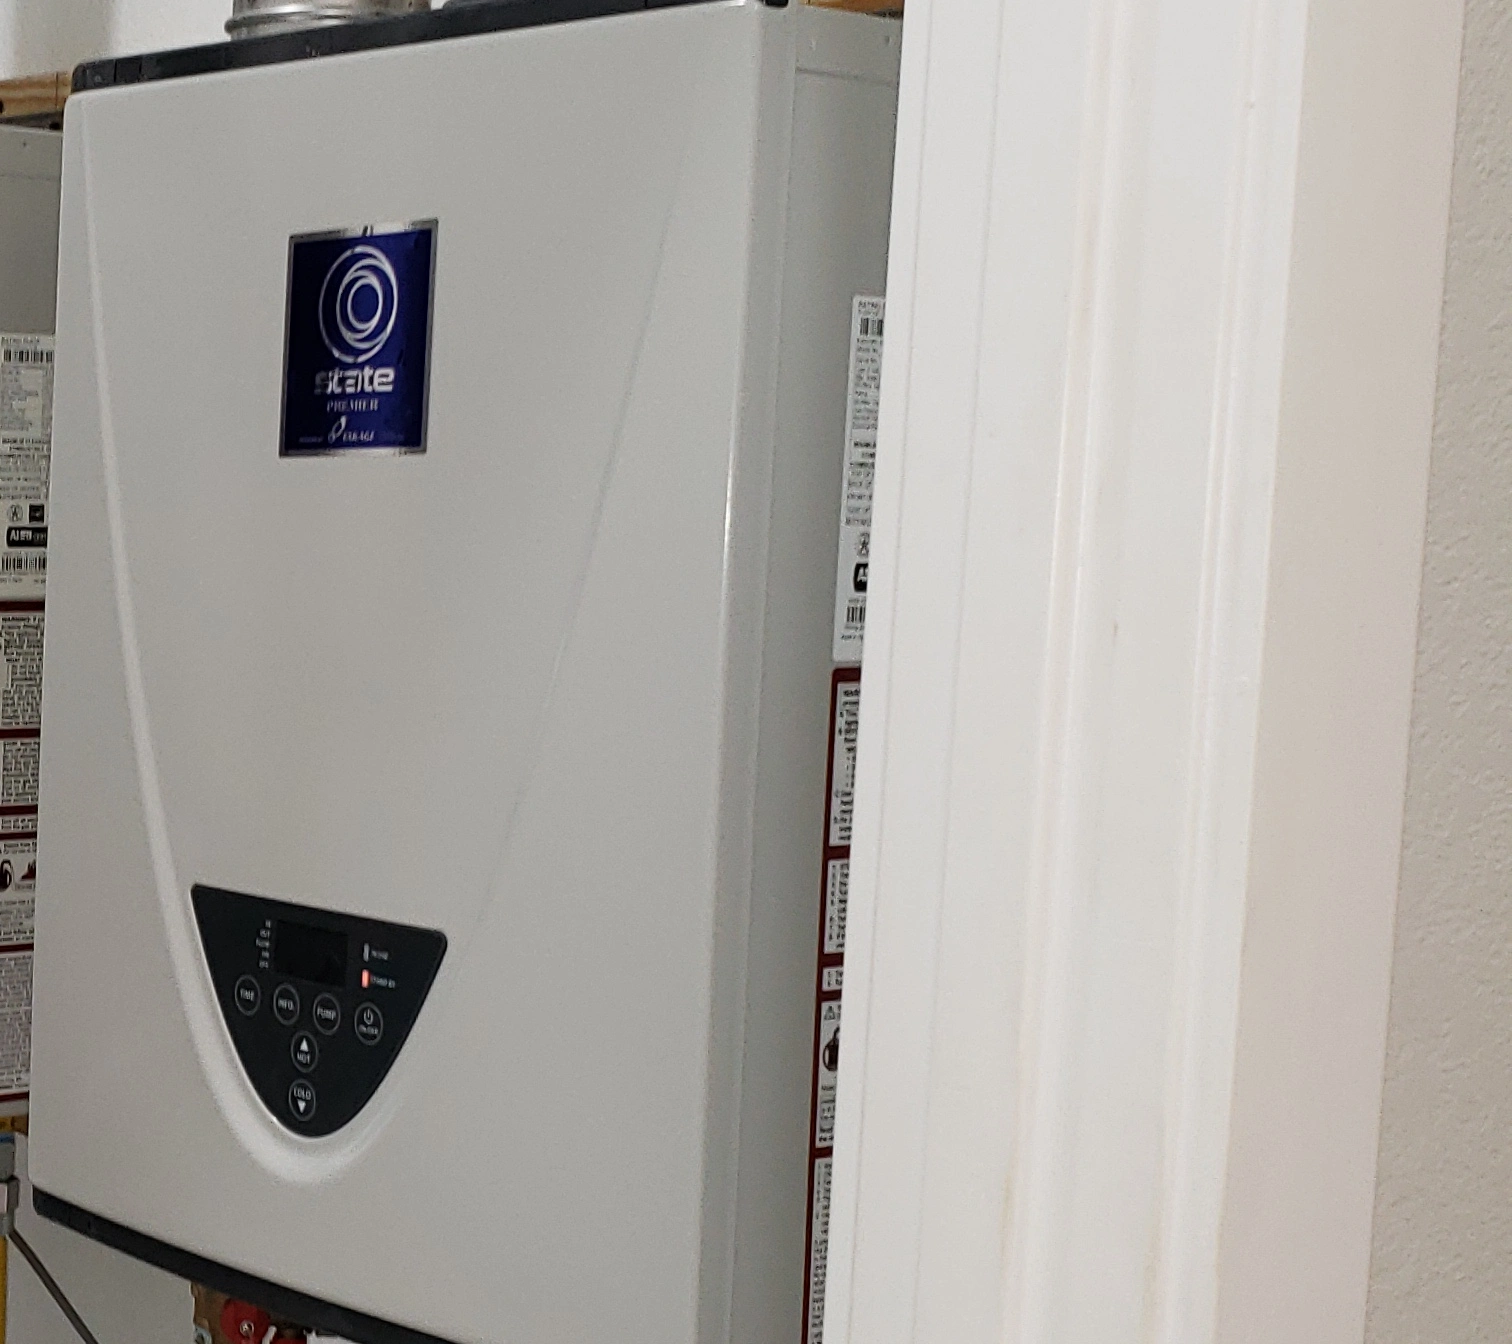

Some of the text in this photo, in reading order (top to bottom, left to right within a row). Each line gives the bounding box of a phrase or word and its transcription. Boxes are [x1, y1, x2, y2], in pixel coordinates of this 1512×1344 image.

[314, 365, 395, 395] state
[297, 1052, 310, 1064] HOT
[293, 1086, 311, 1100] COLD
